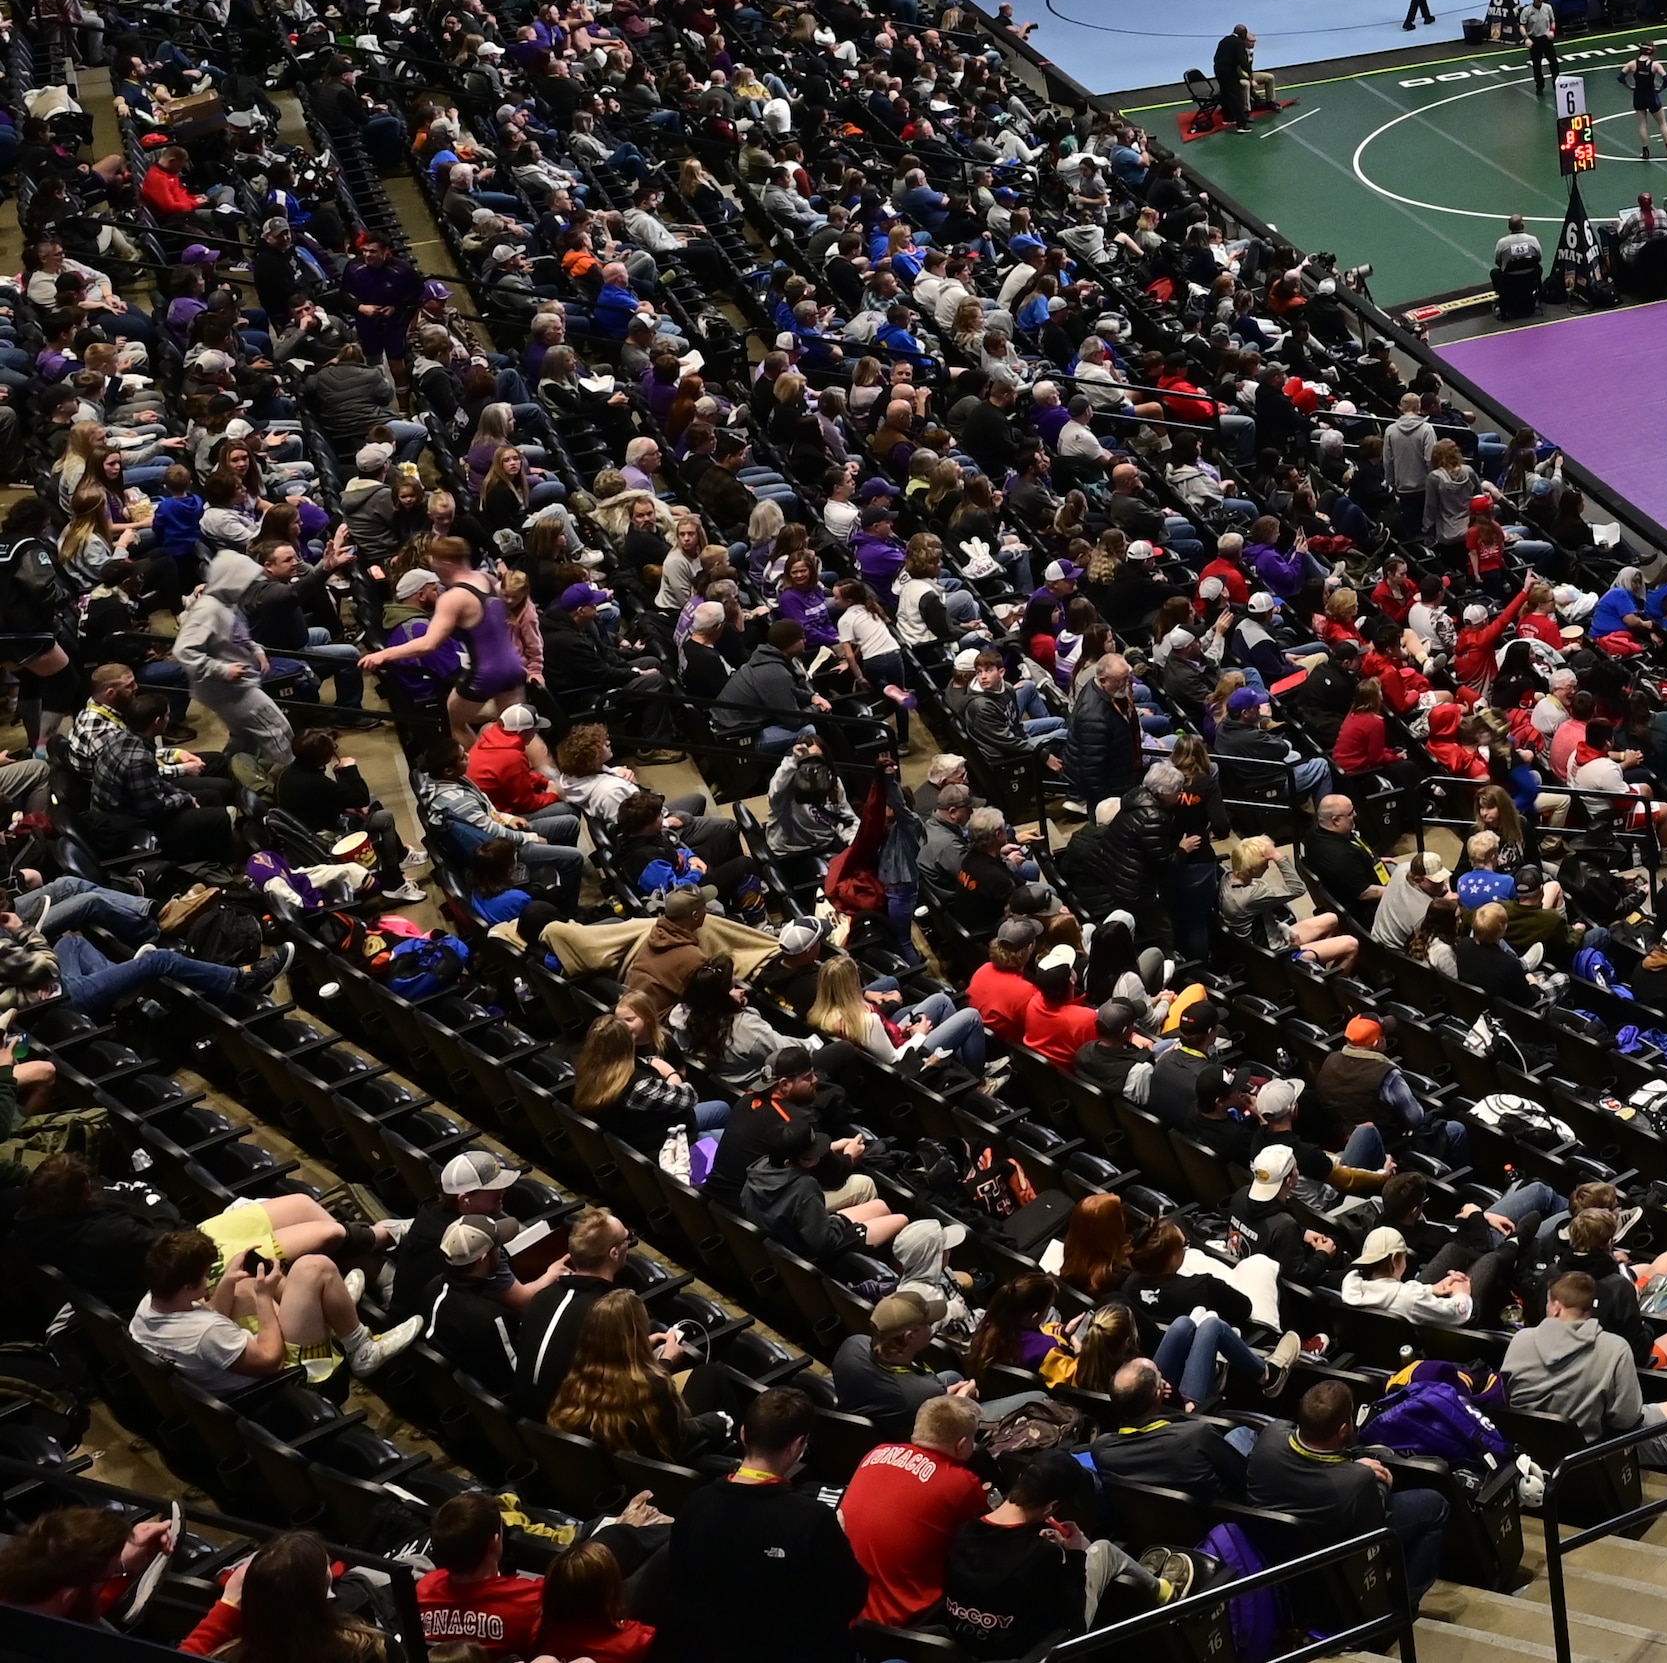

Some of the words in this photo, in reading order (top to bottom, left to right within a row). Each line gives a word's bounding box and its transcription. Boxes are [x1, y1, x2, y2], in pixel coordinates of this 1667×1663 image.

[1567, 91, 1575, 115] 6
[1571, 116, 1590, 131] 107
[1573, 158, 1593, 172] 147
[1566, 222, 1577, 249] 6
[1558, 248, 1583, 265] MAT
[1622, 1467, 1632, 1486] 13
[1500, 1518, 1512, 1538] 14
[1363, 1571, 1377, 1591] 15
[947, 1597, 1015, 1630] McCOY
[1208, 1631, 1223, 1655] 16
